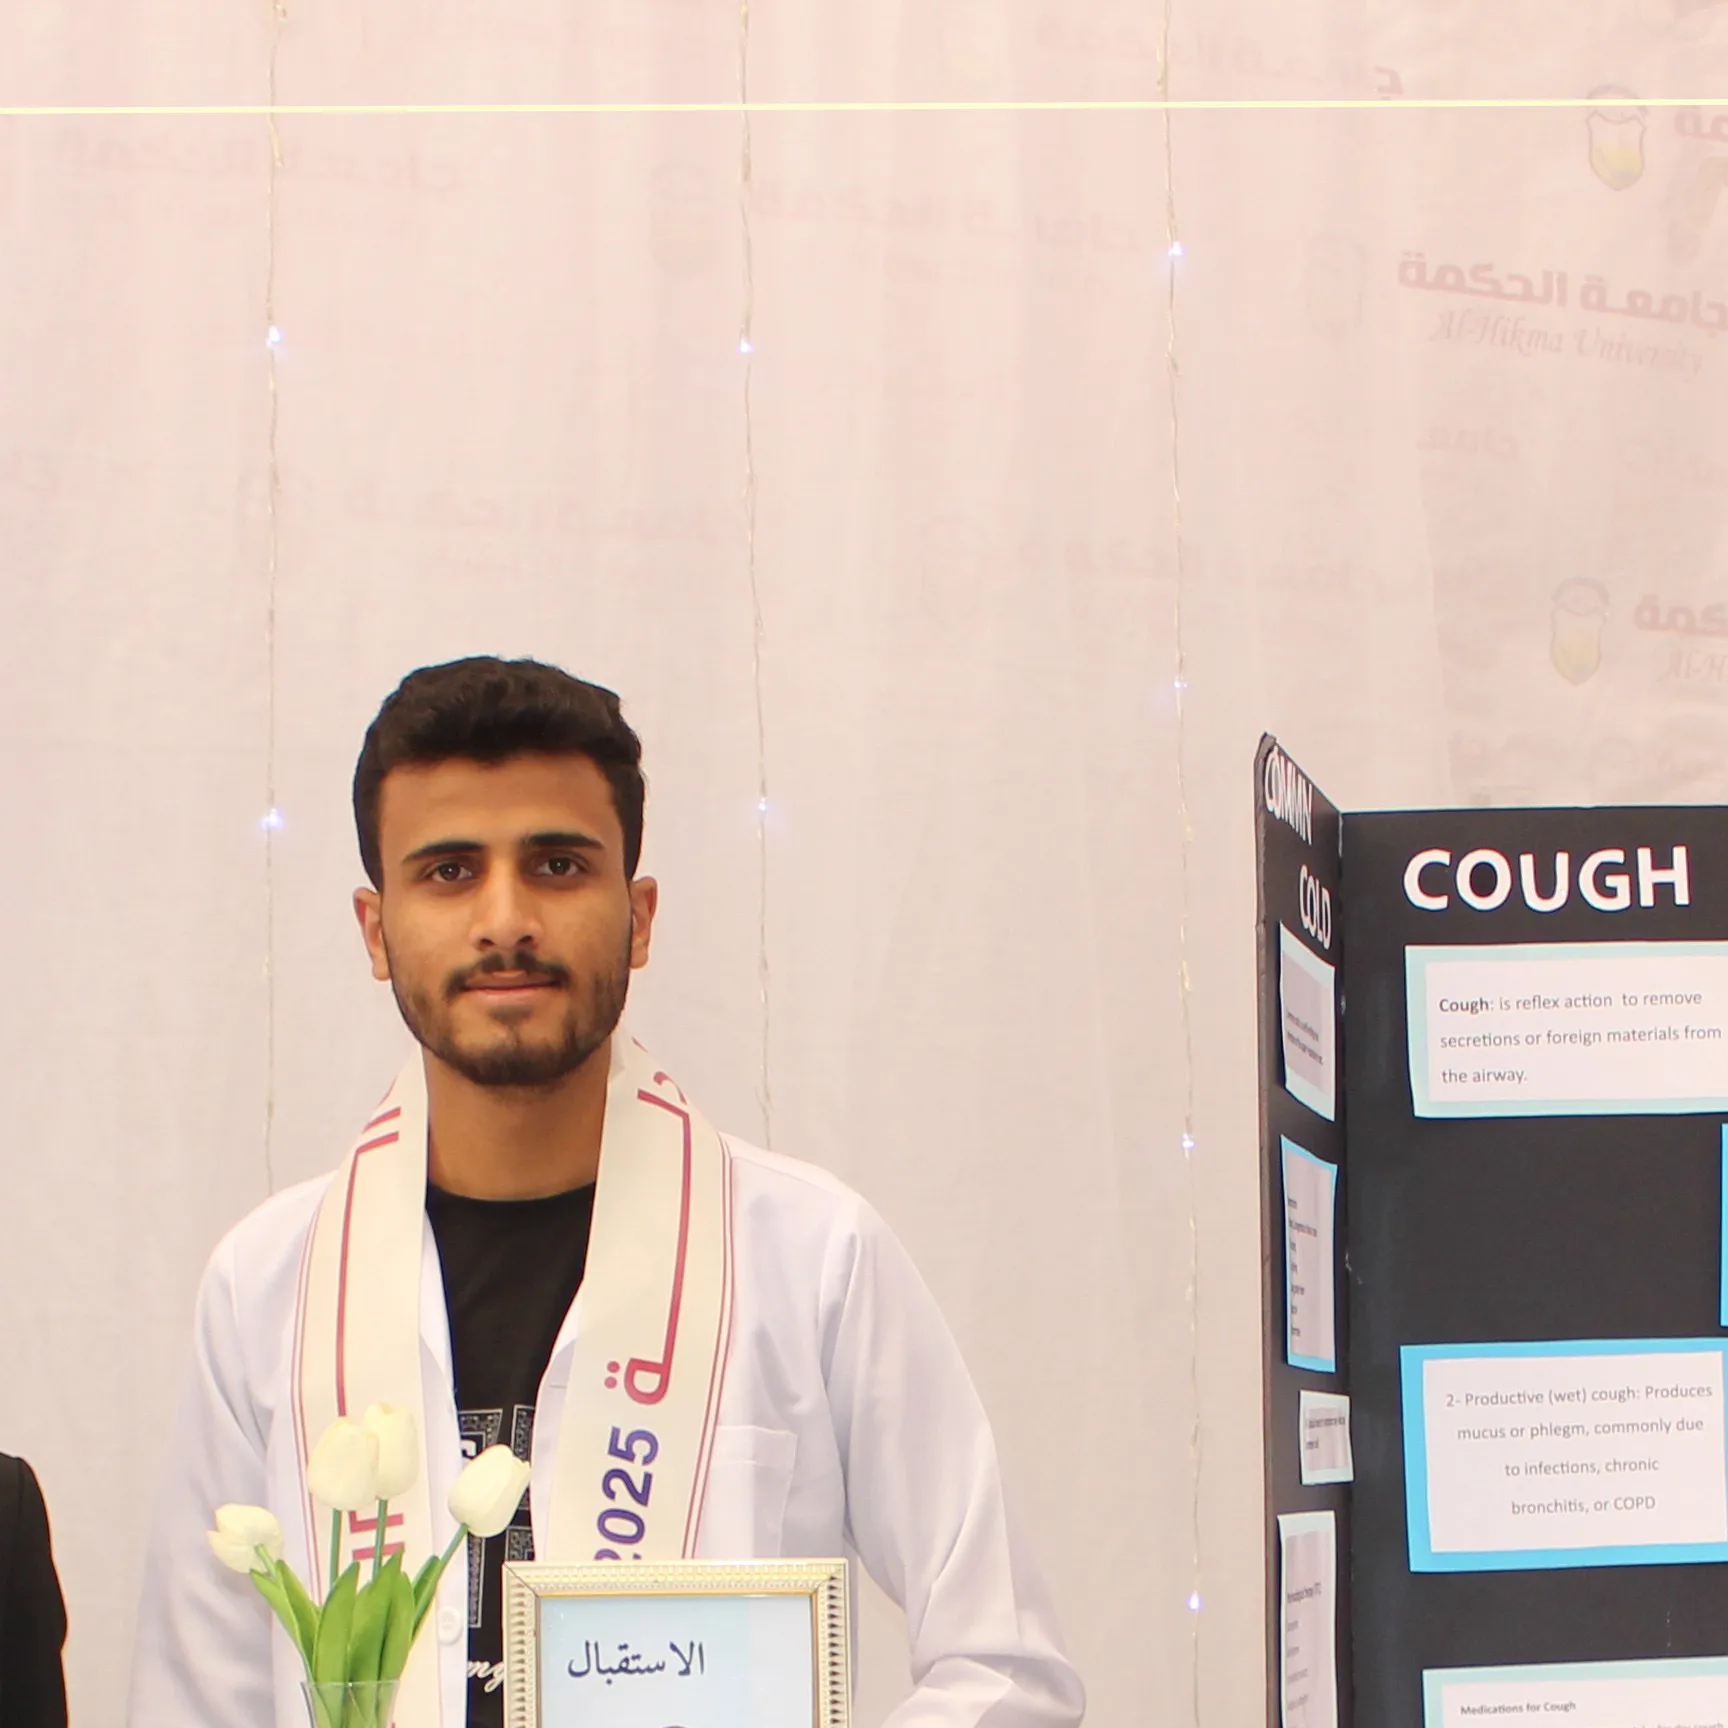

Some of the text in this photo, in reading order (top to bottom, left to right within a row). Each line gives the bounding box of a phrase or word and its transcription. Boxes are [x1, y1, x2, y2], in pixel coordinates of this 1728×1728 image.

[1402, 845, 1691, 913] COUGH
[1298, 863, 1331, 951] COLD
[1438, 993, 1702, 1016] Cough: is reflex action to remove
[1440, 1024, 1722, 1049] secretions or foreign materials from
[1441, 1068, 1528, 1085] the airway.
[1464, 1390, 1544, 1407] Productive
[1548, 1387, 1587, 1406] (wet)
[1591, 1385, 1640, 1404] cough:
[1644, 1383, 1713, 1399] Produces
[1457, 1416, 1704, 1441] mucus or phlegm, commonly due
[1504, 1457, 1660, 1477] to infections, chronic
[592, 1425, 659, 1561] 025
[1511, 1495, 1656, 1516] bronchitis, or COPD
[1460, 1700, 1576, 1716] Medications for Cough
